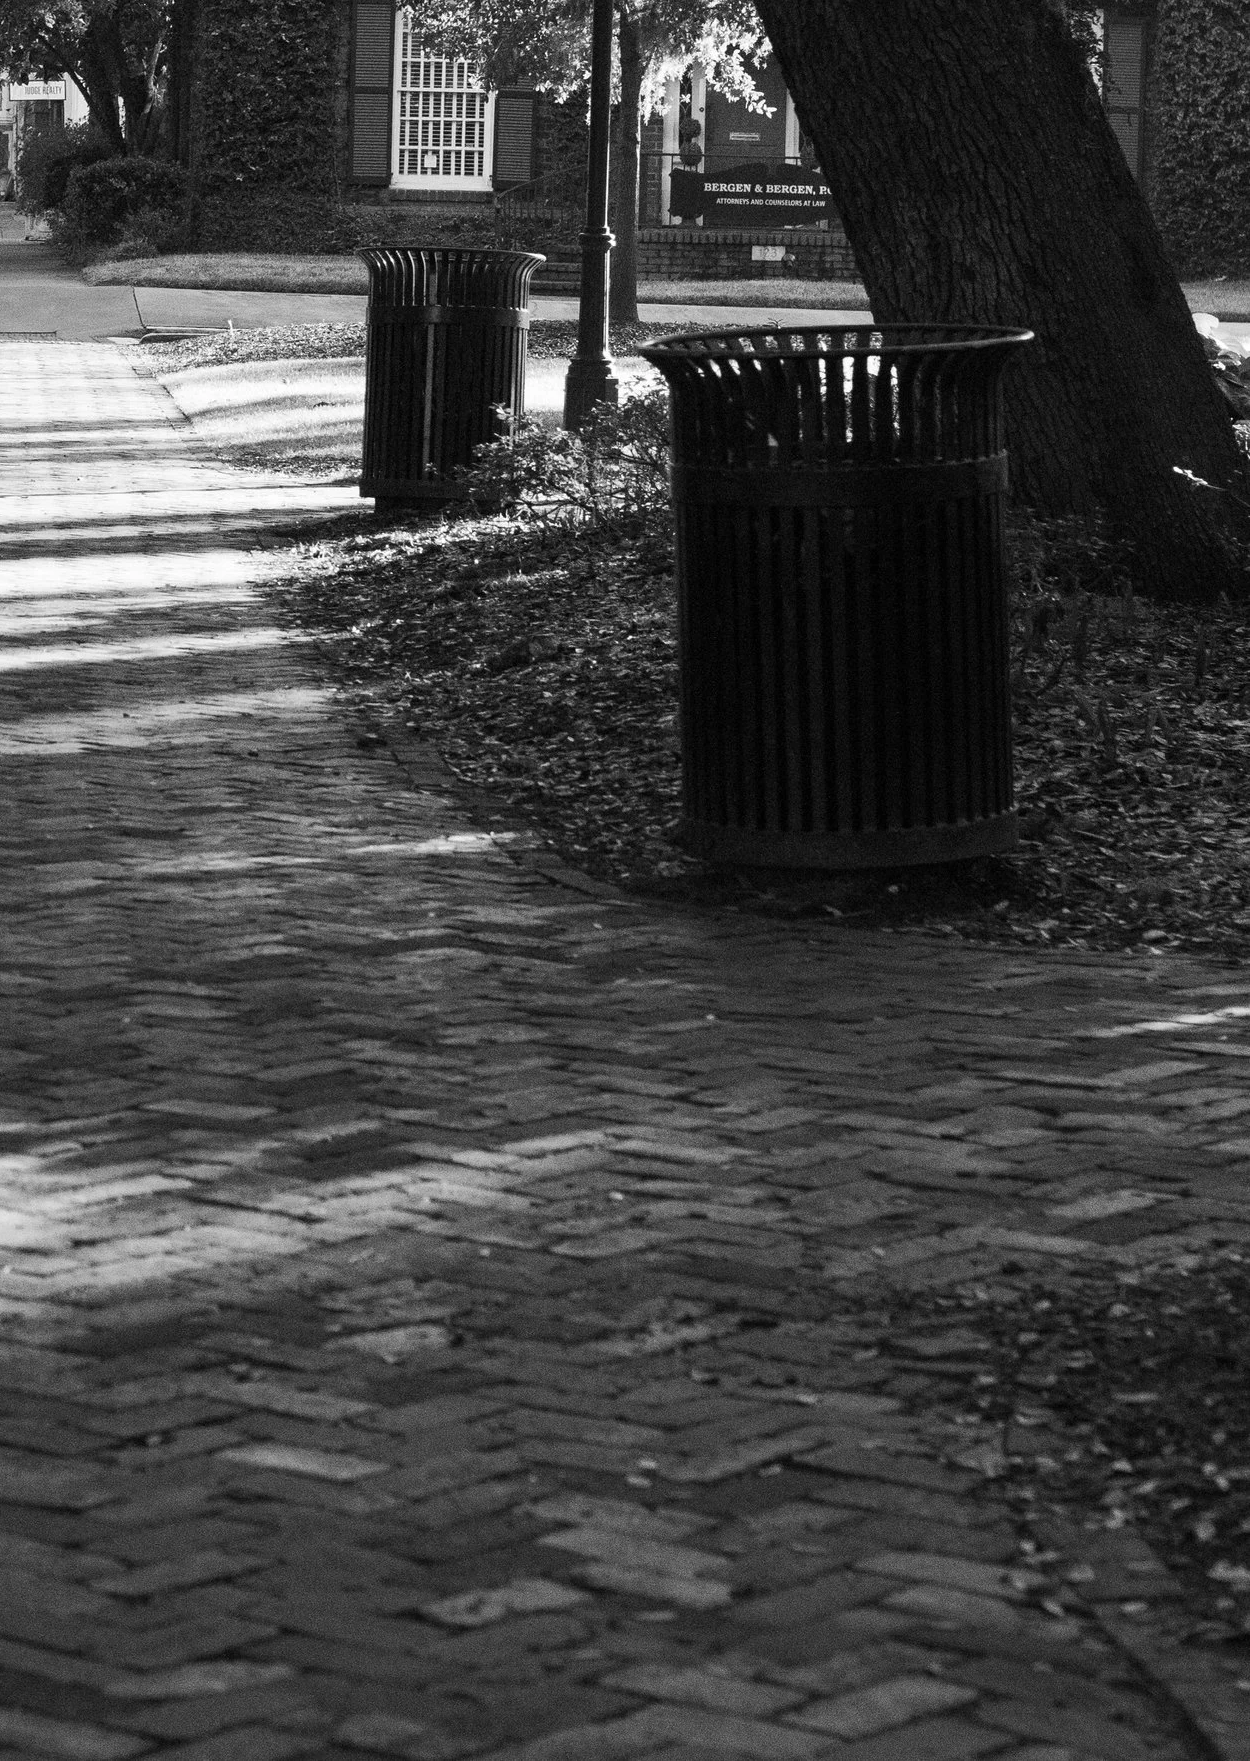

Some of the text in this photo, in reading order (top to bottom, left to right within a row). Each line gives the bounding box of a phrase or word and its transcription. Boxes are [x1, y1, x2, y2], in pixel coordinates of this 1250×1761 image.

[42, 86, 62, 95] REALTY
[704, 183, 751, 193] BERGEN
[754, 184, 763, 193] &
[765, 184, 816, 195] BERGEN,
[765, 199, 802, 207] COUNSELORS
[759, 247, 777, 259] 123
